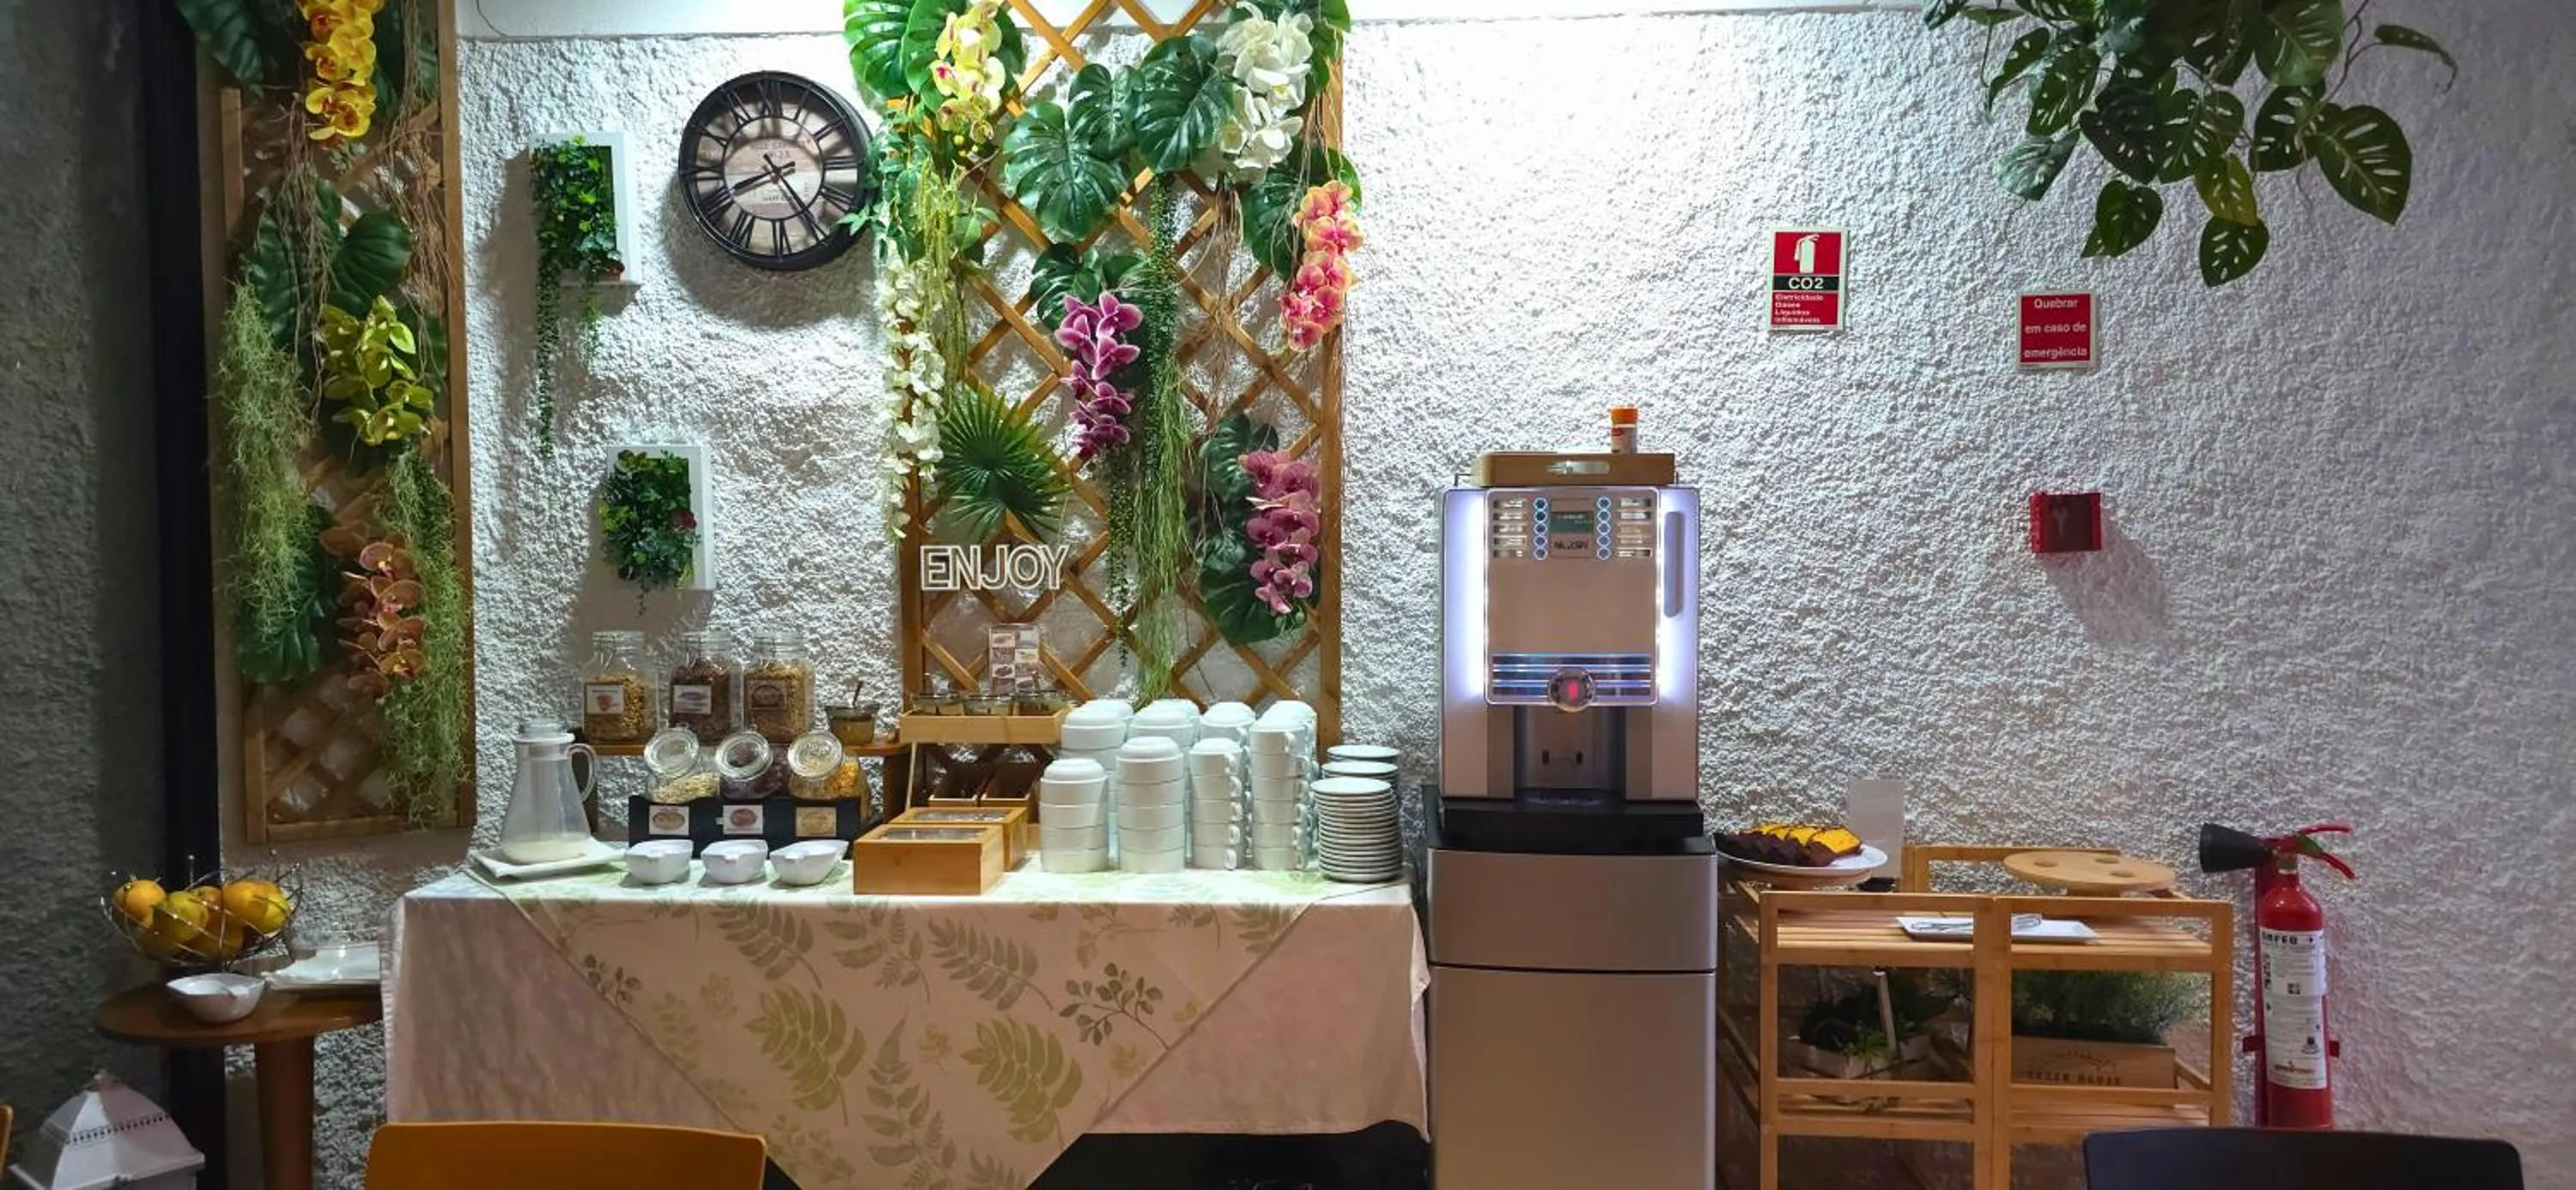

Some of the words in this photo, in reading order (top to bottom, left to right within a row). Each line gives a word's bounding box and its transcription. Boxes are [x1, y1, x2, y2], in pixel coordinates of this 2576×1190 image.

[1789, 277, 1824, 289] CO2
[2033, 297, 2079, 309] Quebrar
[2044, 324, 2070, 332] caso
[2072, 321, 2087, 332] de
[2024, 347, 2087, 359] emergência
[920, 544, 1070, 591] ENJOY
